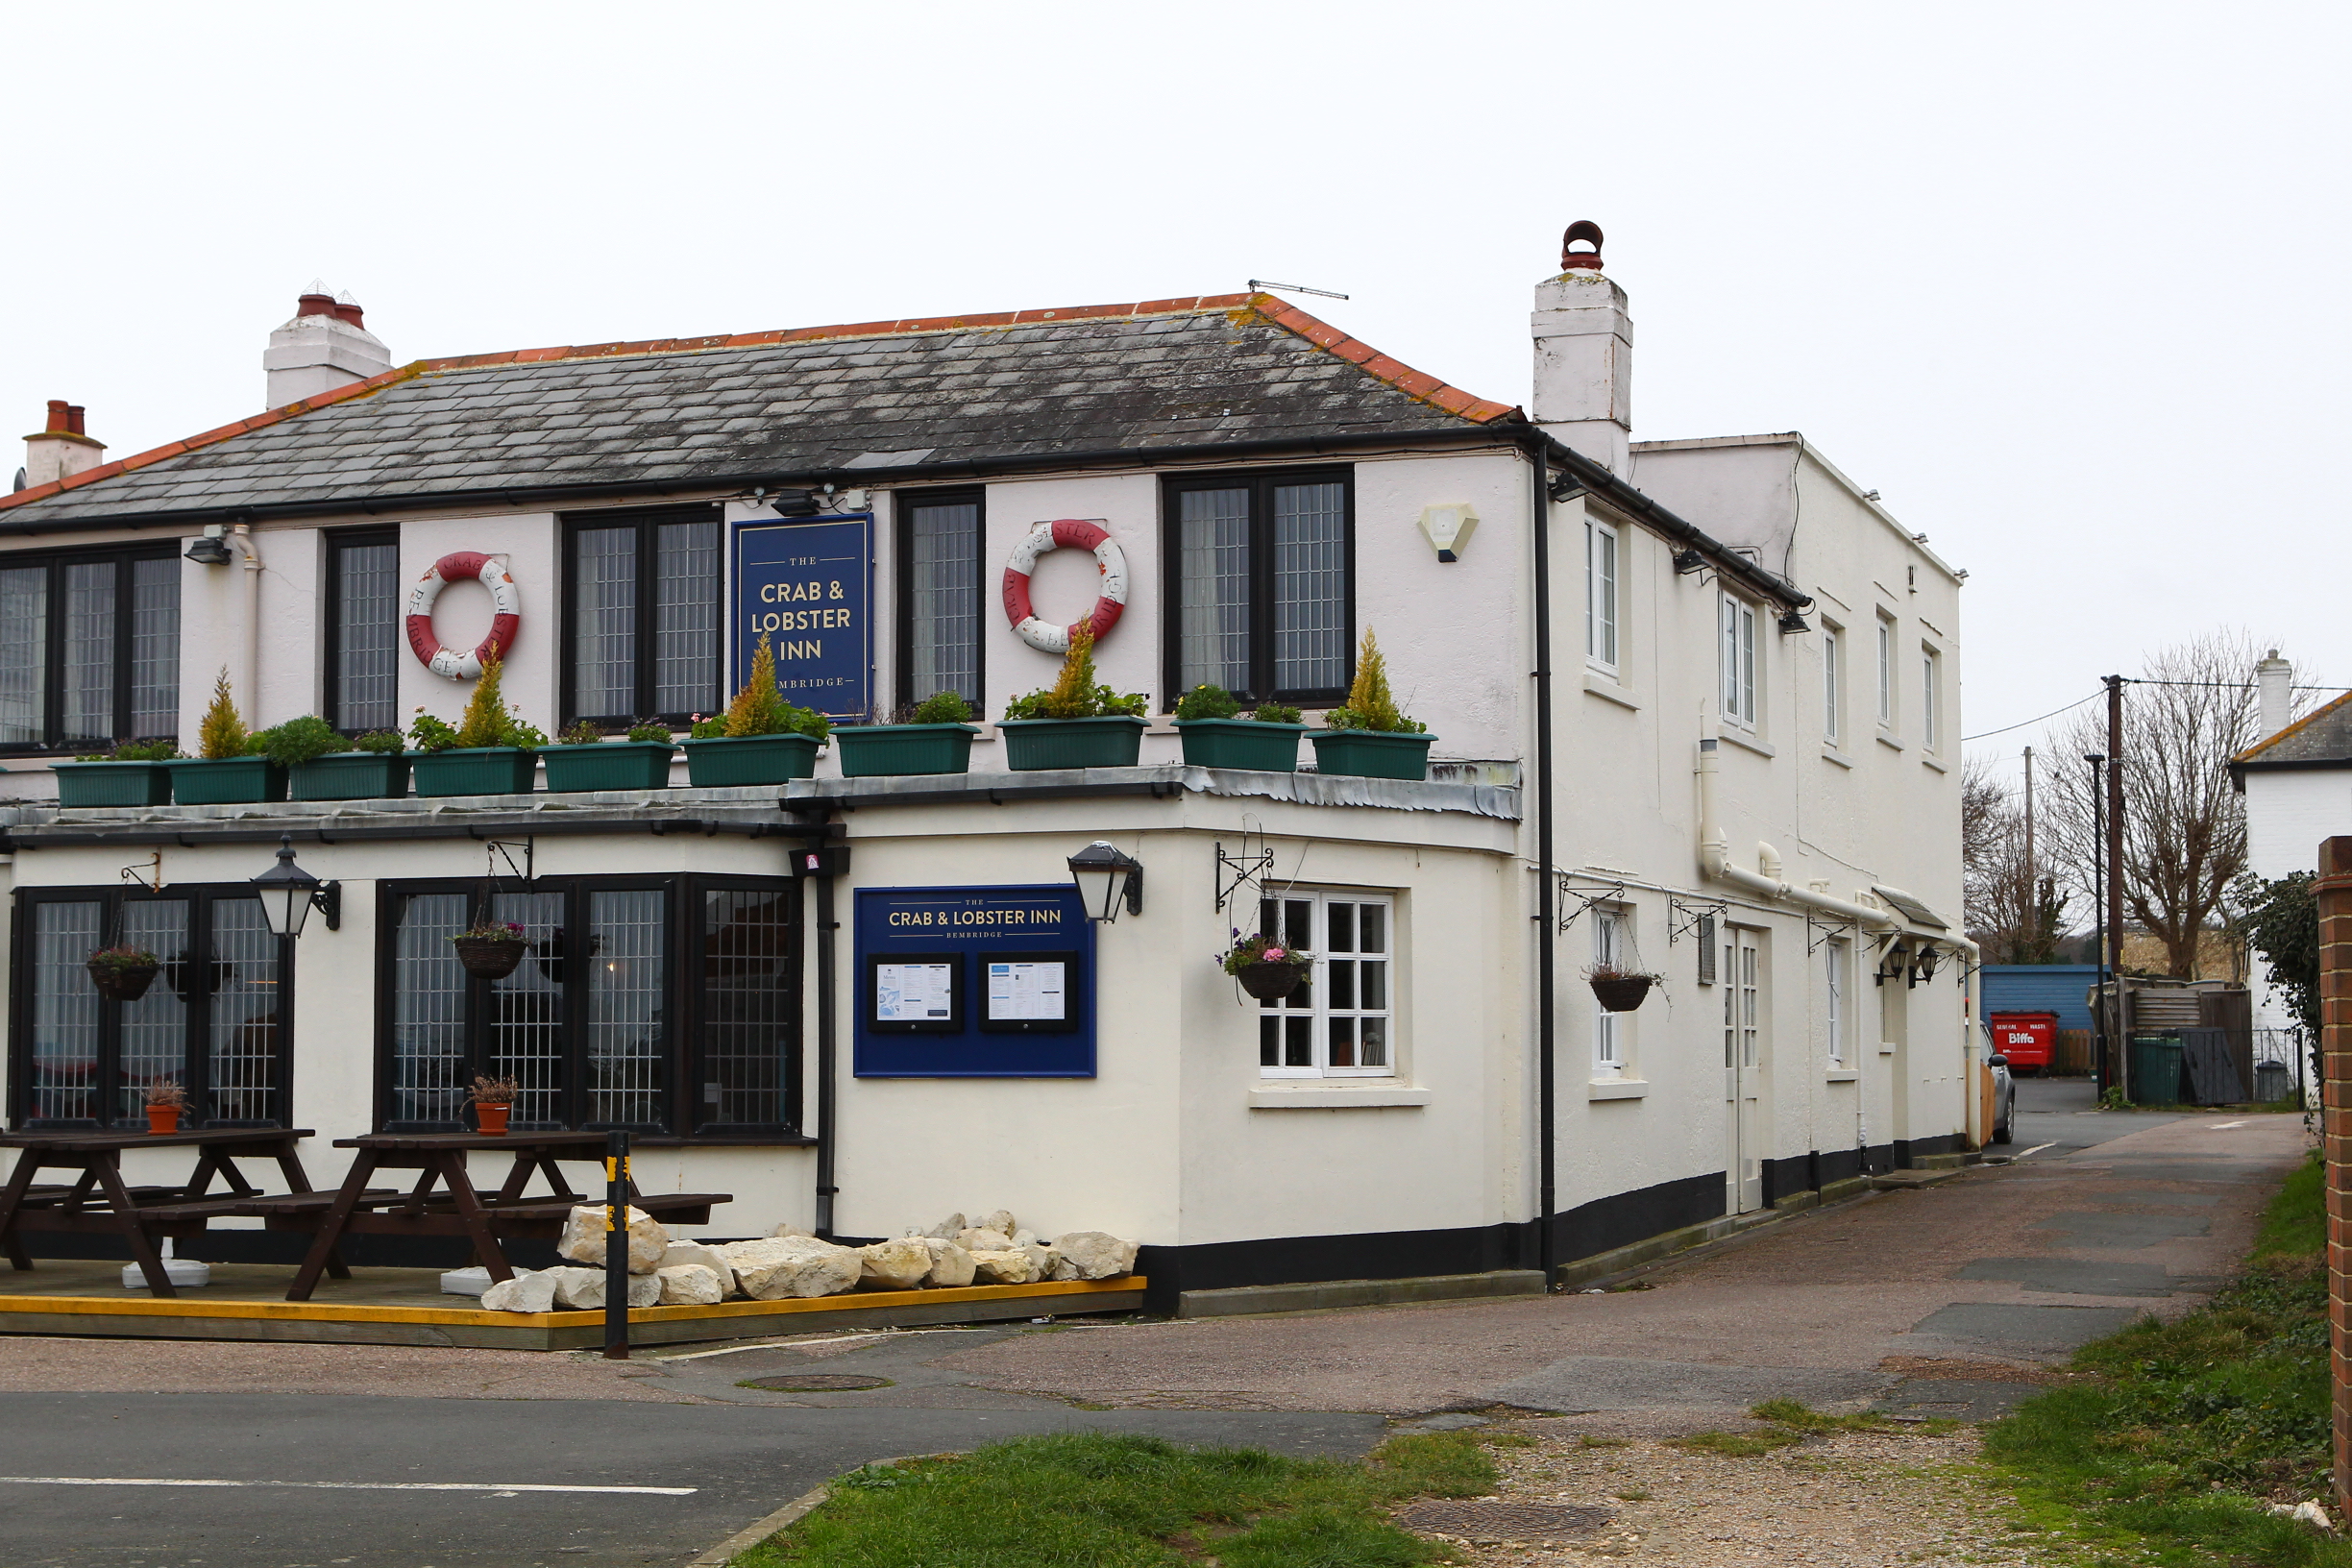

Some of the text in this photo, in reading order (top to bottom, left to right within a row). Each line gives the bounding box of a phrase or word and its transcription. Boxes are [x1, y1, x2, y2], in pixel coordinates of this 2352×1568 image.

[443, 555, 482, 571] CRAB
[789, 556, 817, 566] THE
[760, 579, 845, 603] CRAB &
[751, 607, 851, 633] LOBSTER
[780, 639, 821, 661] INN
[774, 676, 844, 690] MBRIDGE
[889, 909, 1061, 926] CRAB & LOBSTER INN
[2008, 1032, 2035, 1044] Biffa
